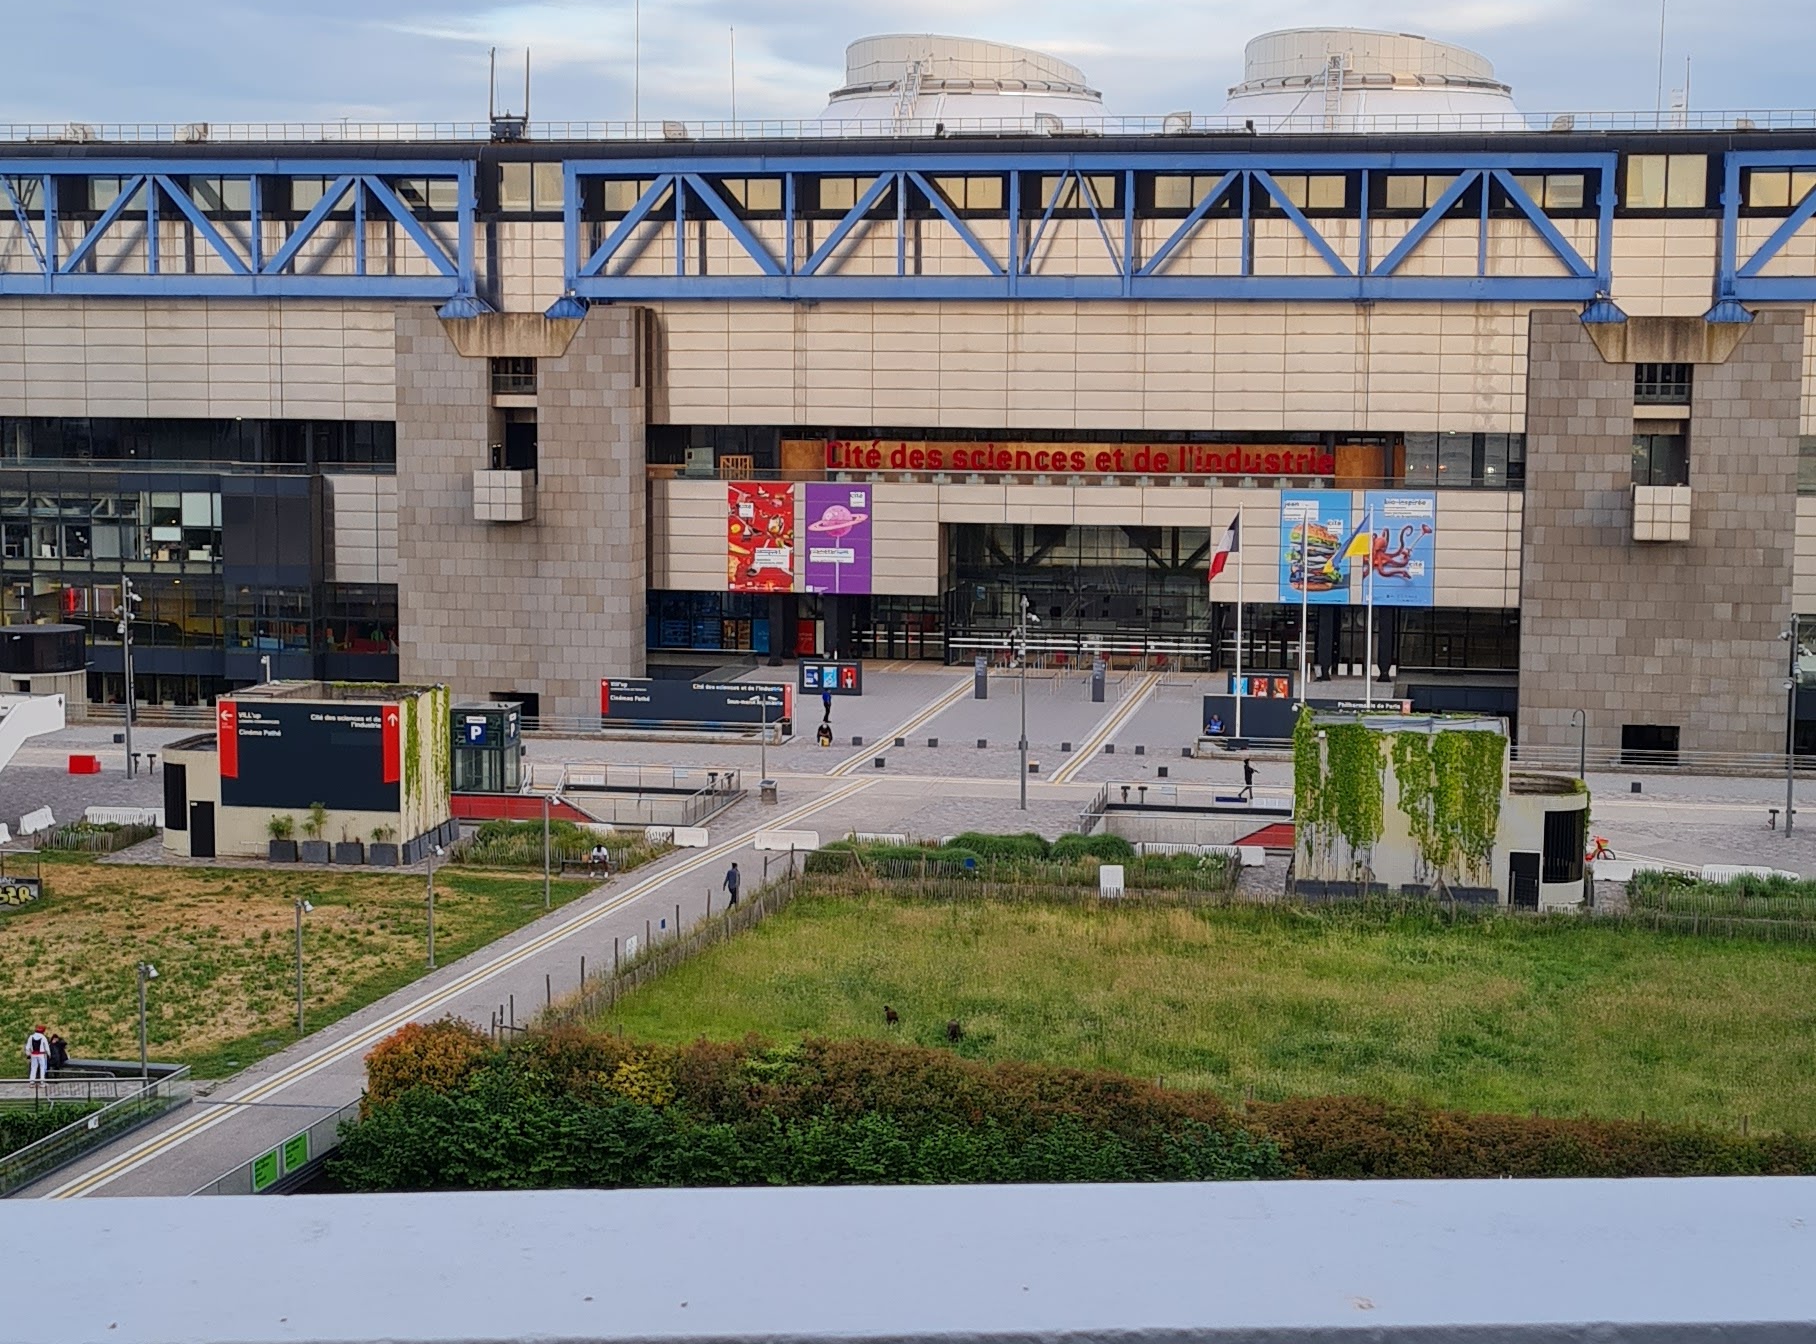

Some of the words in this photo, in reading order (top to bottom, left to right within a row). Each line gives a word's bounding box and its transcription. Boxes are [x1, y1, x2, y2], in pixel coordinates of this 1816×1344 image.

[826, 440, 881, 468] Cité
[890, 443, 943, 470] des
[953, 443, 1086, 471] sciences
[1096, 448, 1124, 472] et
[1134, 446, 1169, 473] de
[1180, 446, 1335, 474] l'industrie
[470, 725, 482, 740] P
